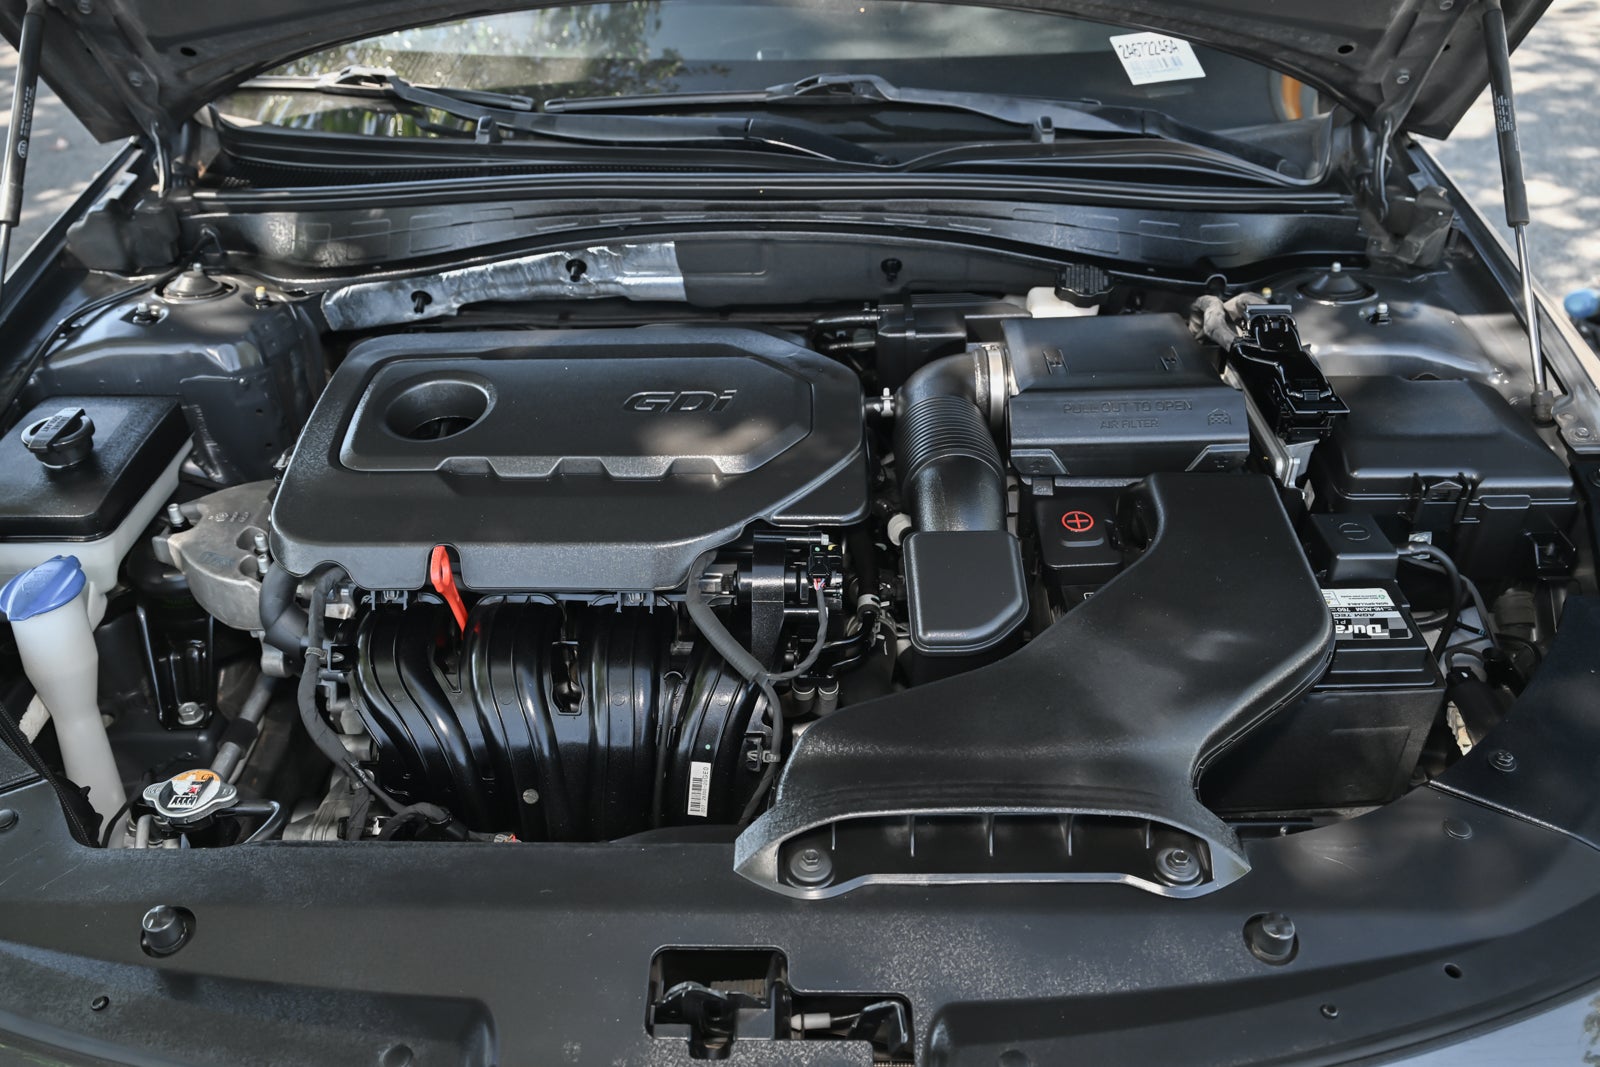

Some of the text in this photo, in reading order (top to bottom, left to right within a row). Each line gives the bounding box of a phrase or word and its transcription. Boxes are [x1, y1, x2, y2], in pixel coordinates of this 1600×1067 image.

[622, 389, 737, 412] GDi
[1063, 400, 1193, 414] PULL OUT TO OPEN
[1100, 419, 1159, 429] AIR FILTER
